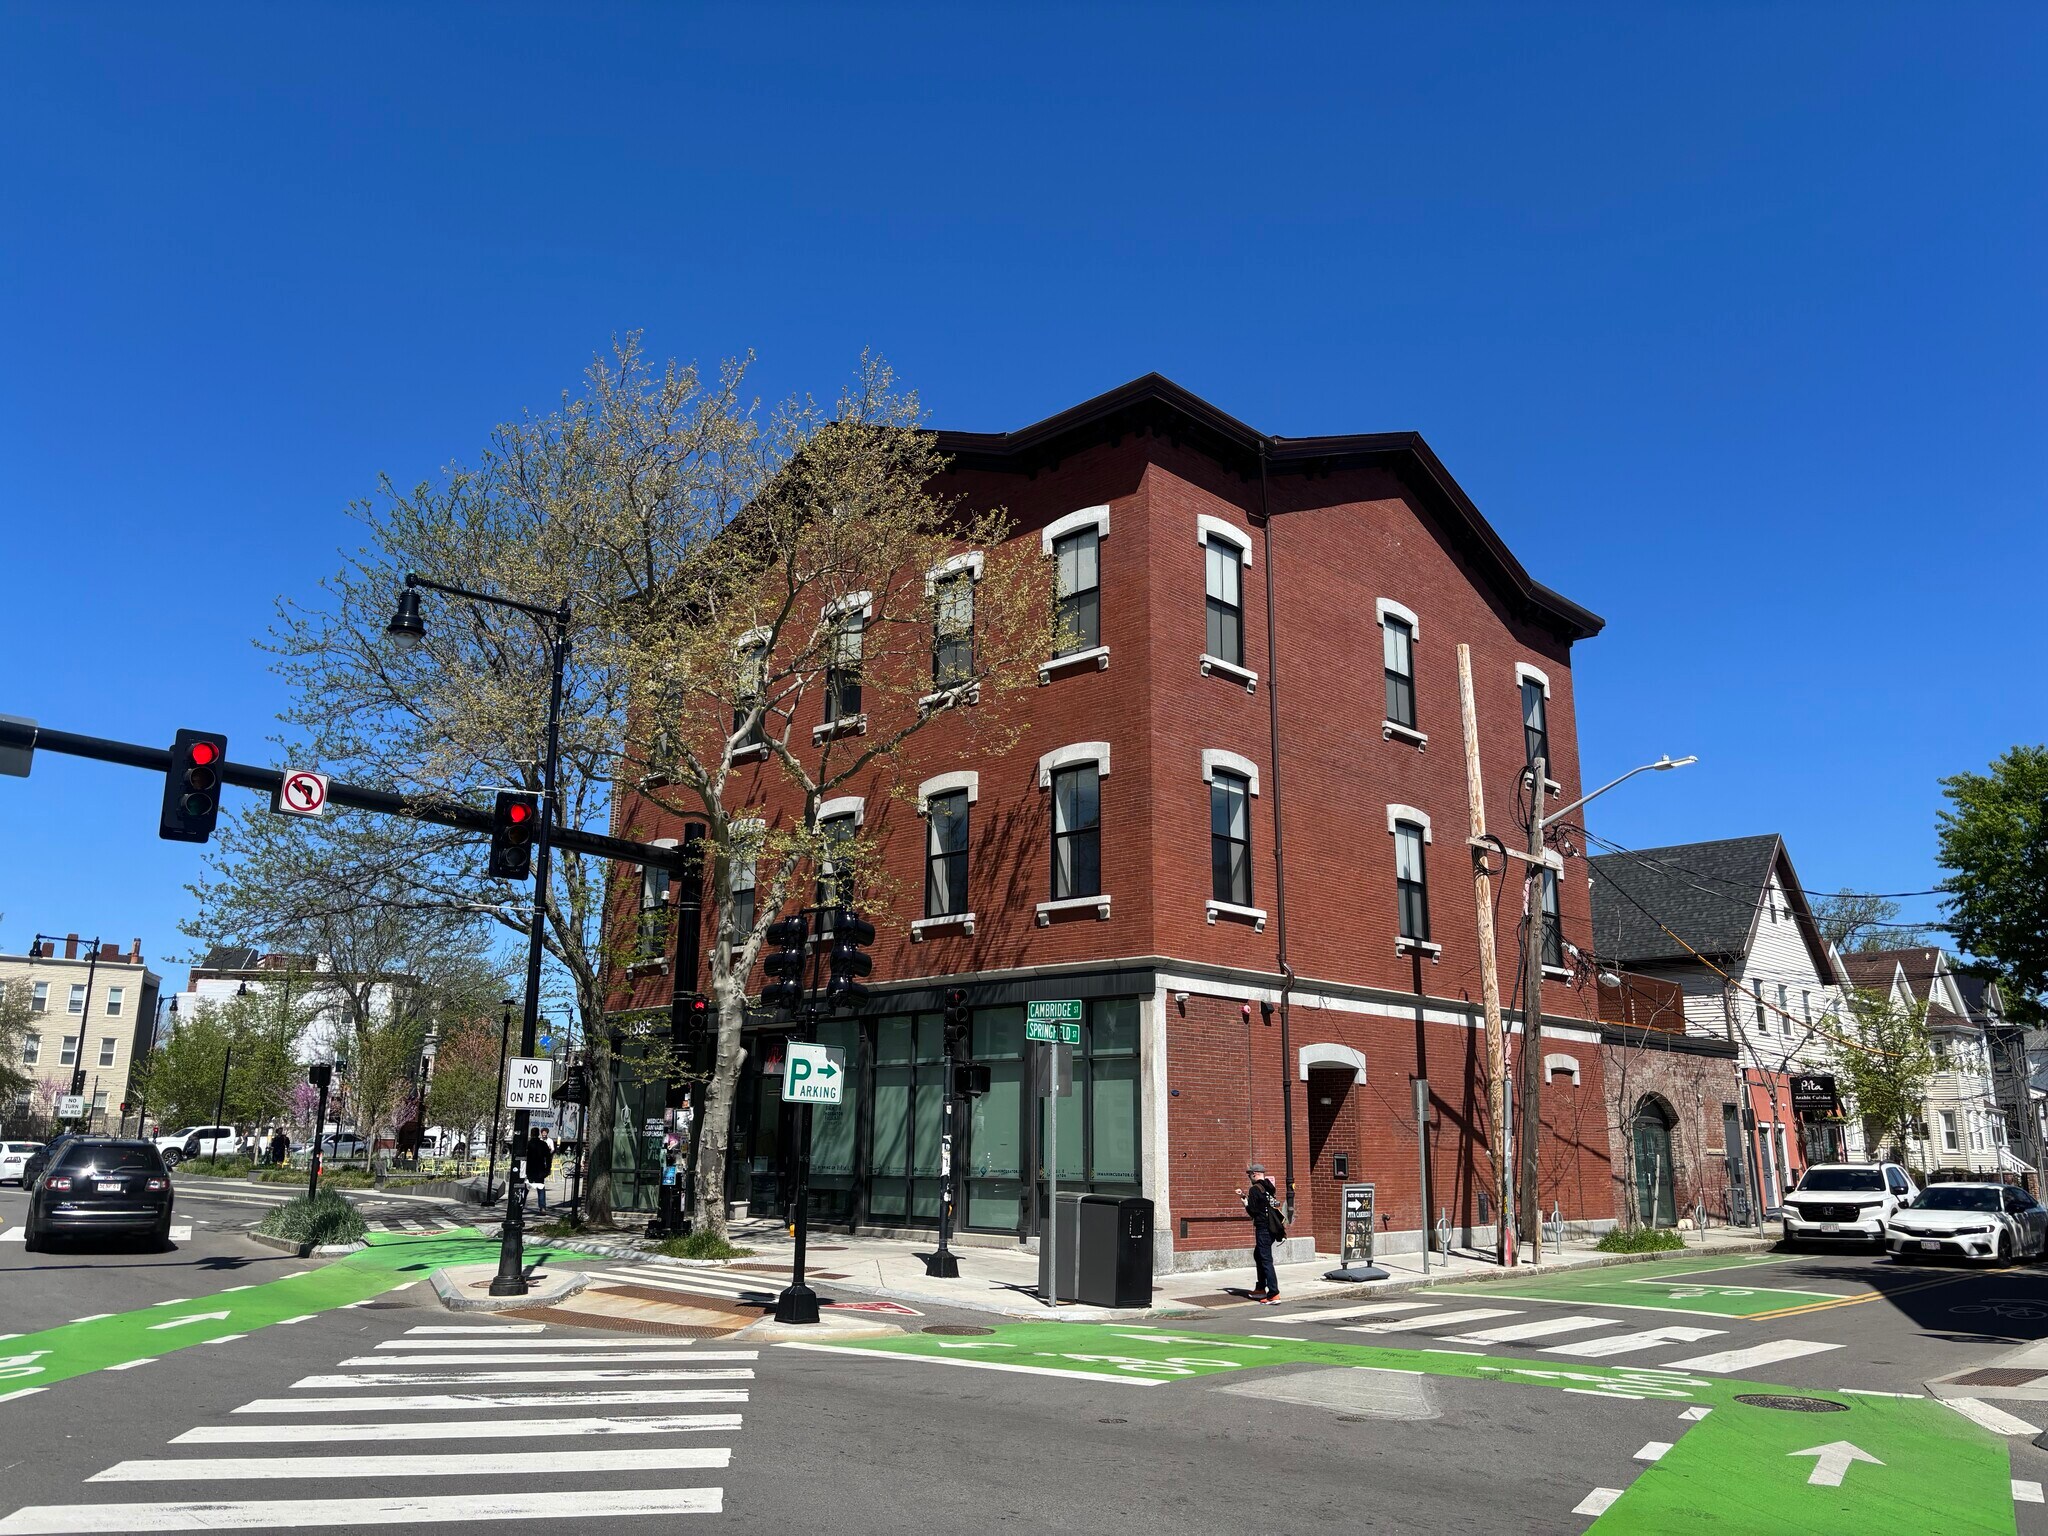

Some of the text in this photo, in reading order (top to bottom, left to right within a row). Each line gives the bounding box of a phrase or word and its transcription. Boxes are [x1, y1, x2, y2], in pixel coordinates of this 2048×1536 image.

[1030, 1003, 1079, 1017] CAMBRIDGE ST
[1028, 1022, 1078, 1041] SPRINGFIELD ST
[523, 1064, 539, 1075] NO
[518, 1078, 543, 1089] TURN
[1801, 1079, 1824, 1092] Pita
[510, 1092, 548, 1103] ON RED
